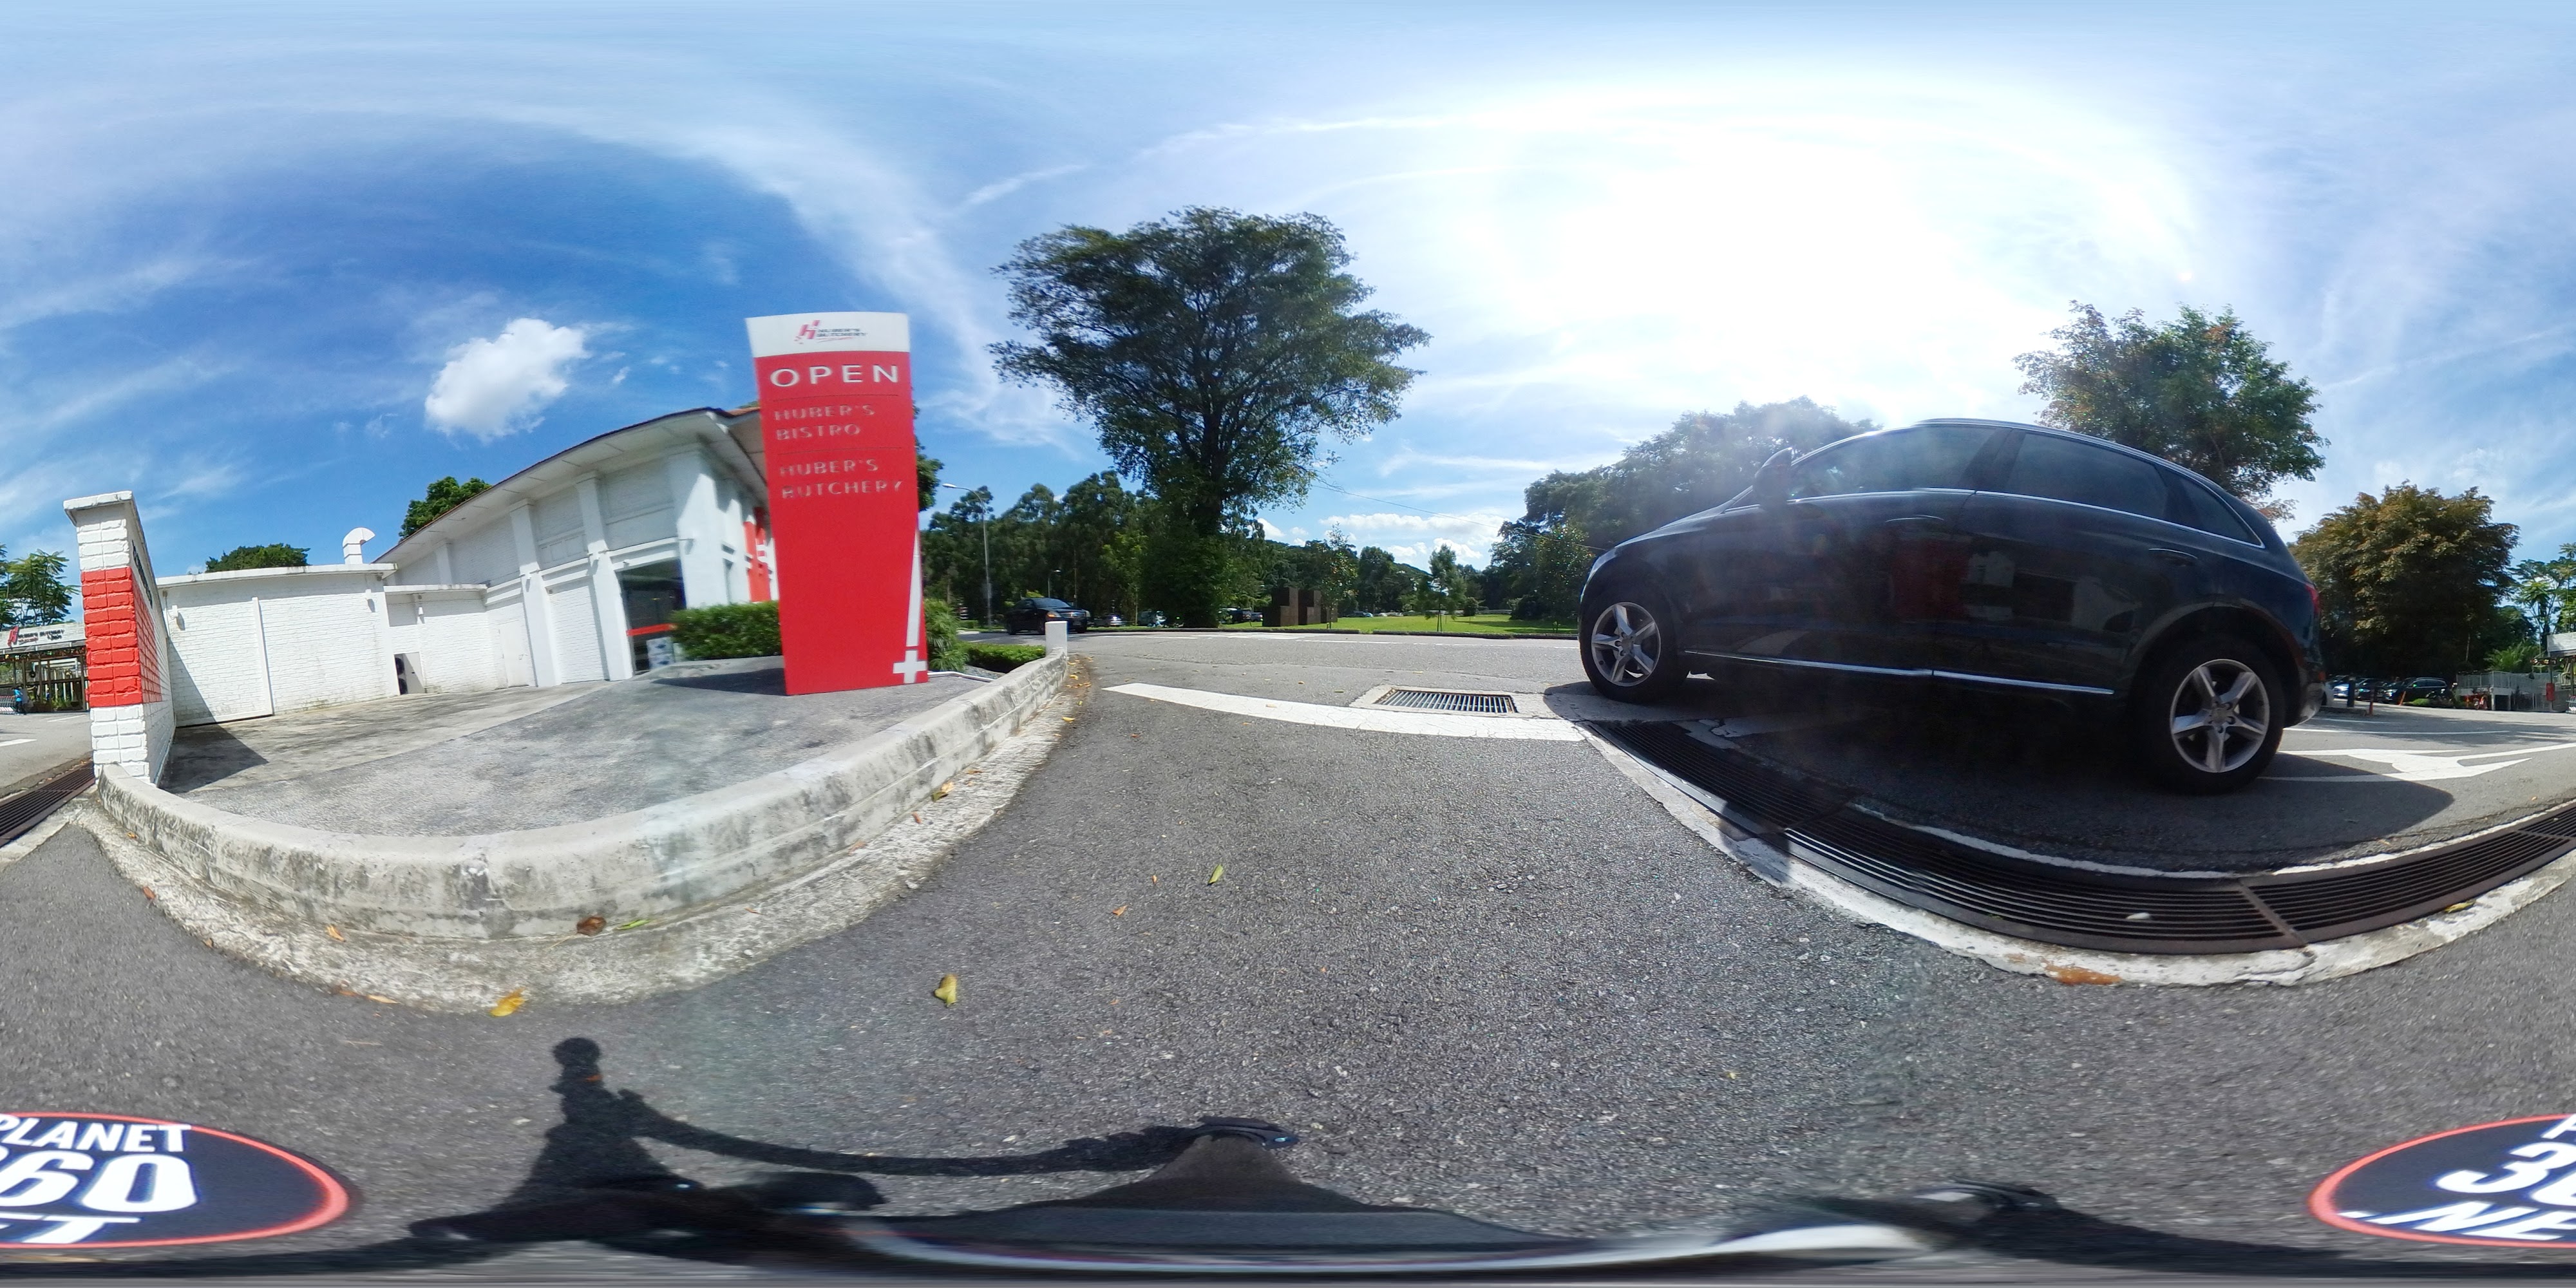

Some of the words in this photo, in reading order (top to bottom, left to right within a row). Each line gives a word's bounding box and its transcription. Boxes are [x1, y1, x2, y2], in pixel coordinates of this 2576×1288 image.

[770, 365, 898, 387] OPEN
[774, 404, 875, 421] HUBER'S
[777, 424, 861, 440] BISTRO
[780, 459, 878, 477] HUBER'S
